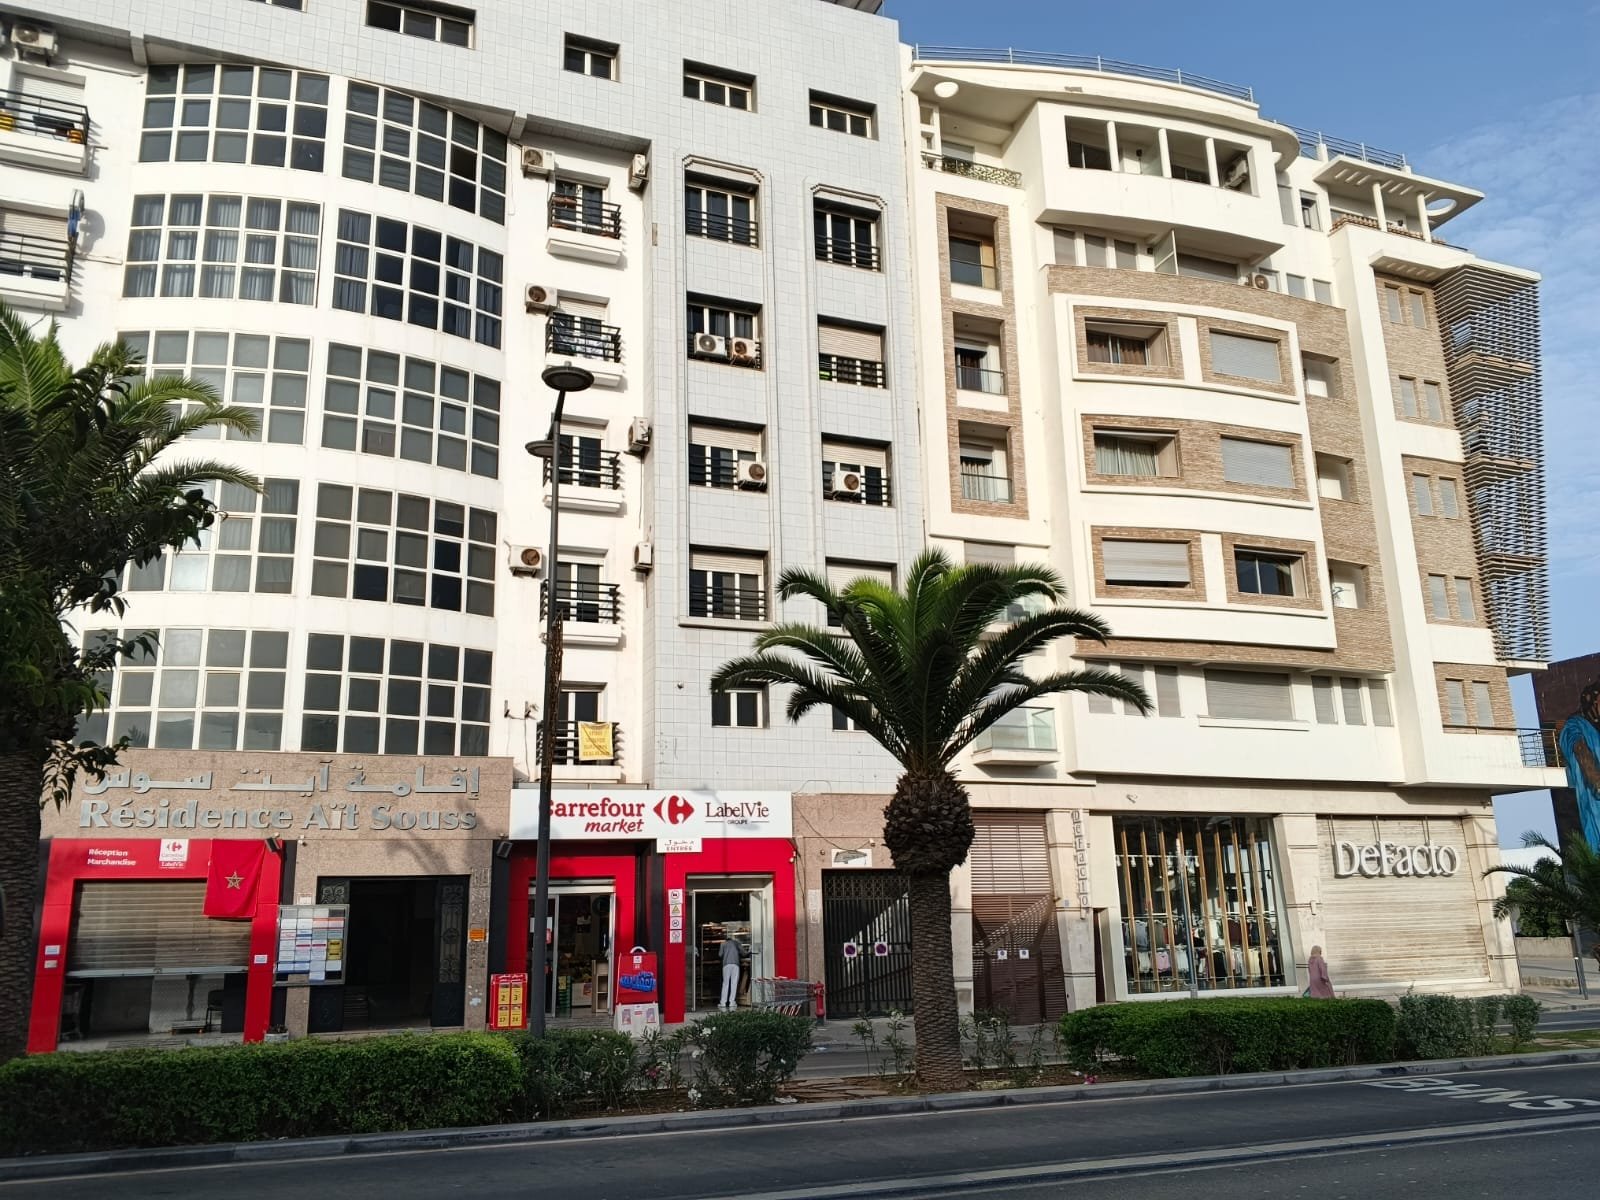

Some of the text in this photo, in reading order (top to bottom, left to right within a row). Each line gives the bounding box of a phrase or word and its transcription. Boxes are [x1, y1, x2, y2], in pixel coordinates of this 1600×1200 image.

[82, 759, 480, 800] إقامة آيت سوس
[79, 799, 477, 830] Résidence Aït Souss
[705, 801, 769, 818] LabelVie
[584, 819, 645, 834] market
[87, 858, 136, 866] Marchandise
[89, 848, 128, 857] Réception
[1334, 840, 1460, 877] DeFacto
[1360, 1077, 1600, 1110] BHNS
